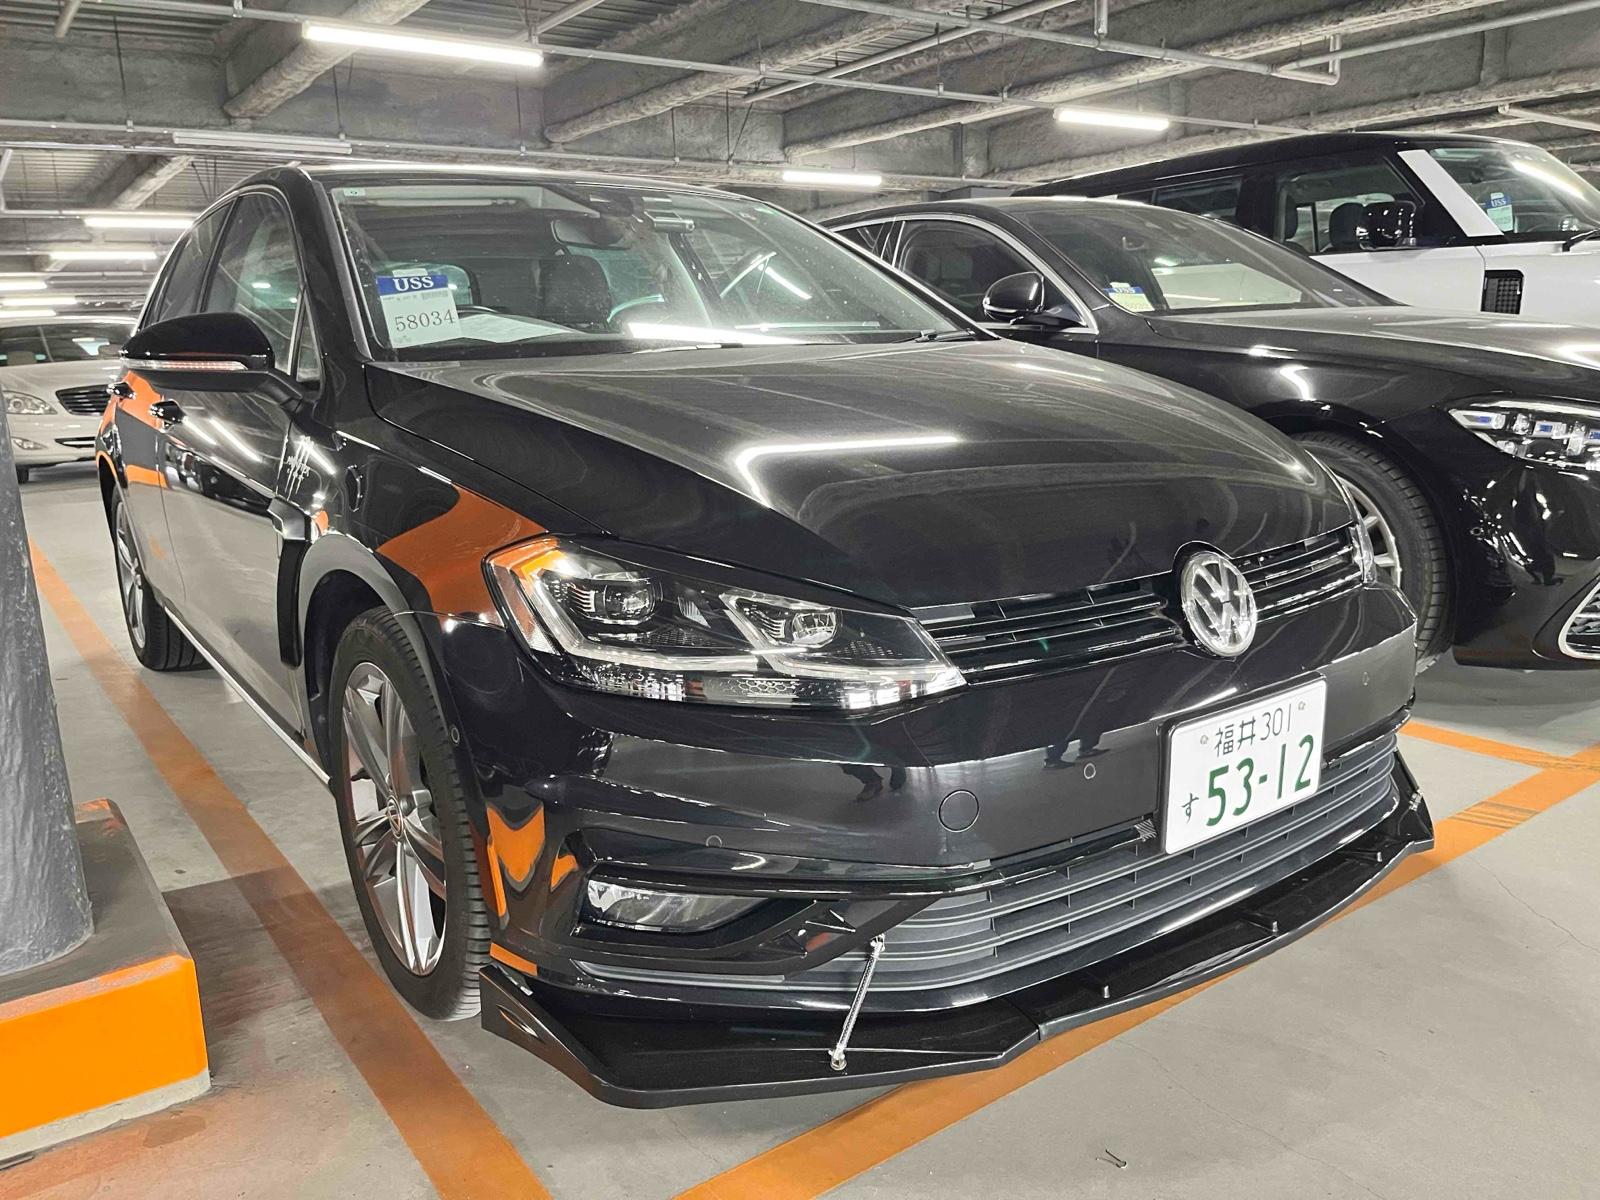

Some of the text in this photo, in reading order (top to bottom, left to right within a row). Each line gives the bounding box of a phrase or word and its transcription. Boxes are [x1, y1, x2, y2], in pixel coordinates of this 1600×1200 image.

[392, 276, 434, 292] USS
[394, 309, 456, 333] 58034
[1205, 734, 1314, 827] 53-12
